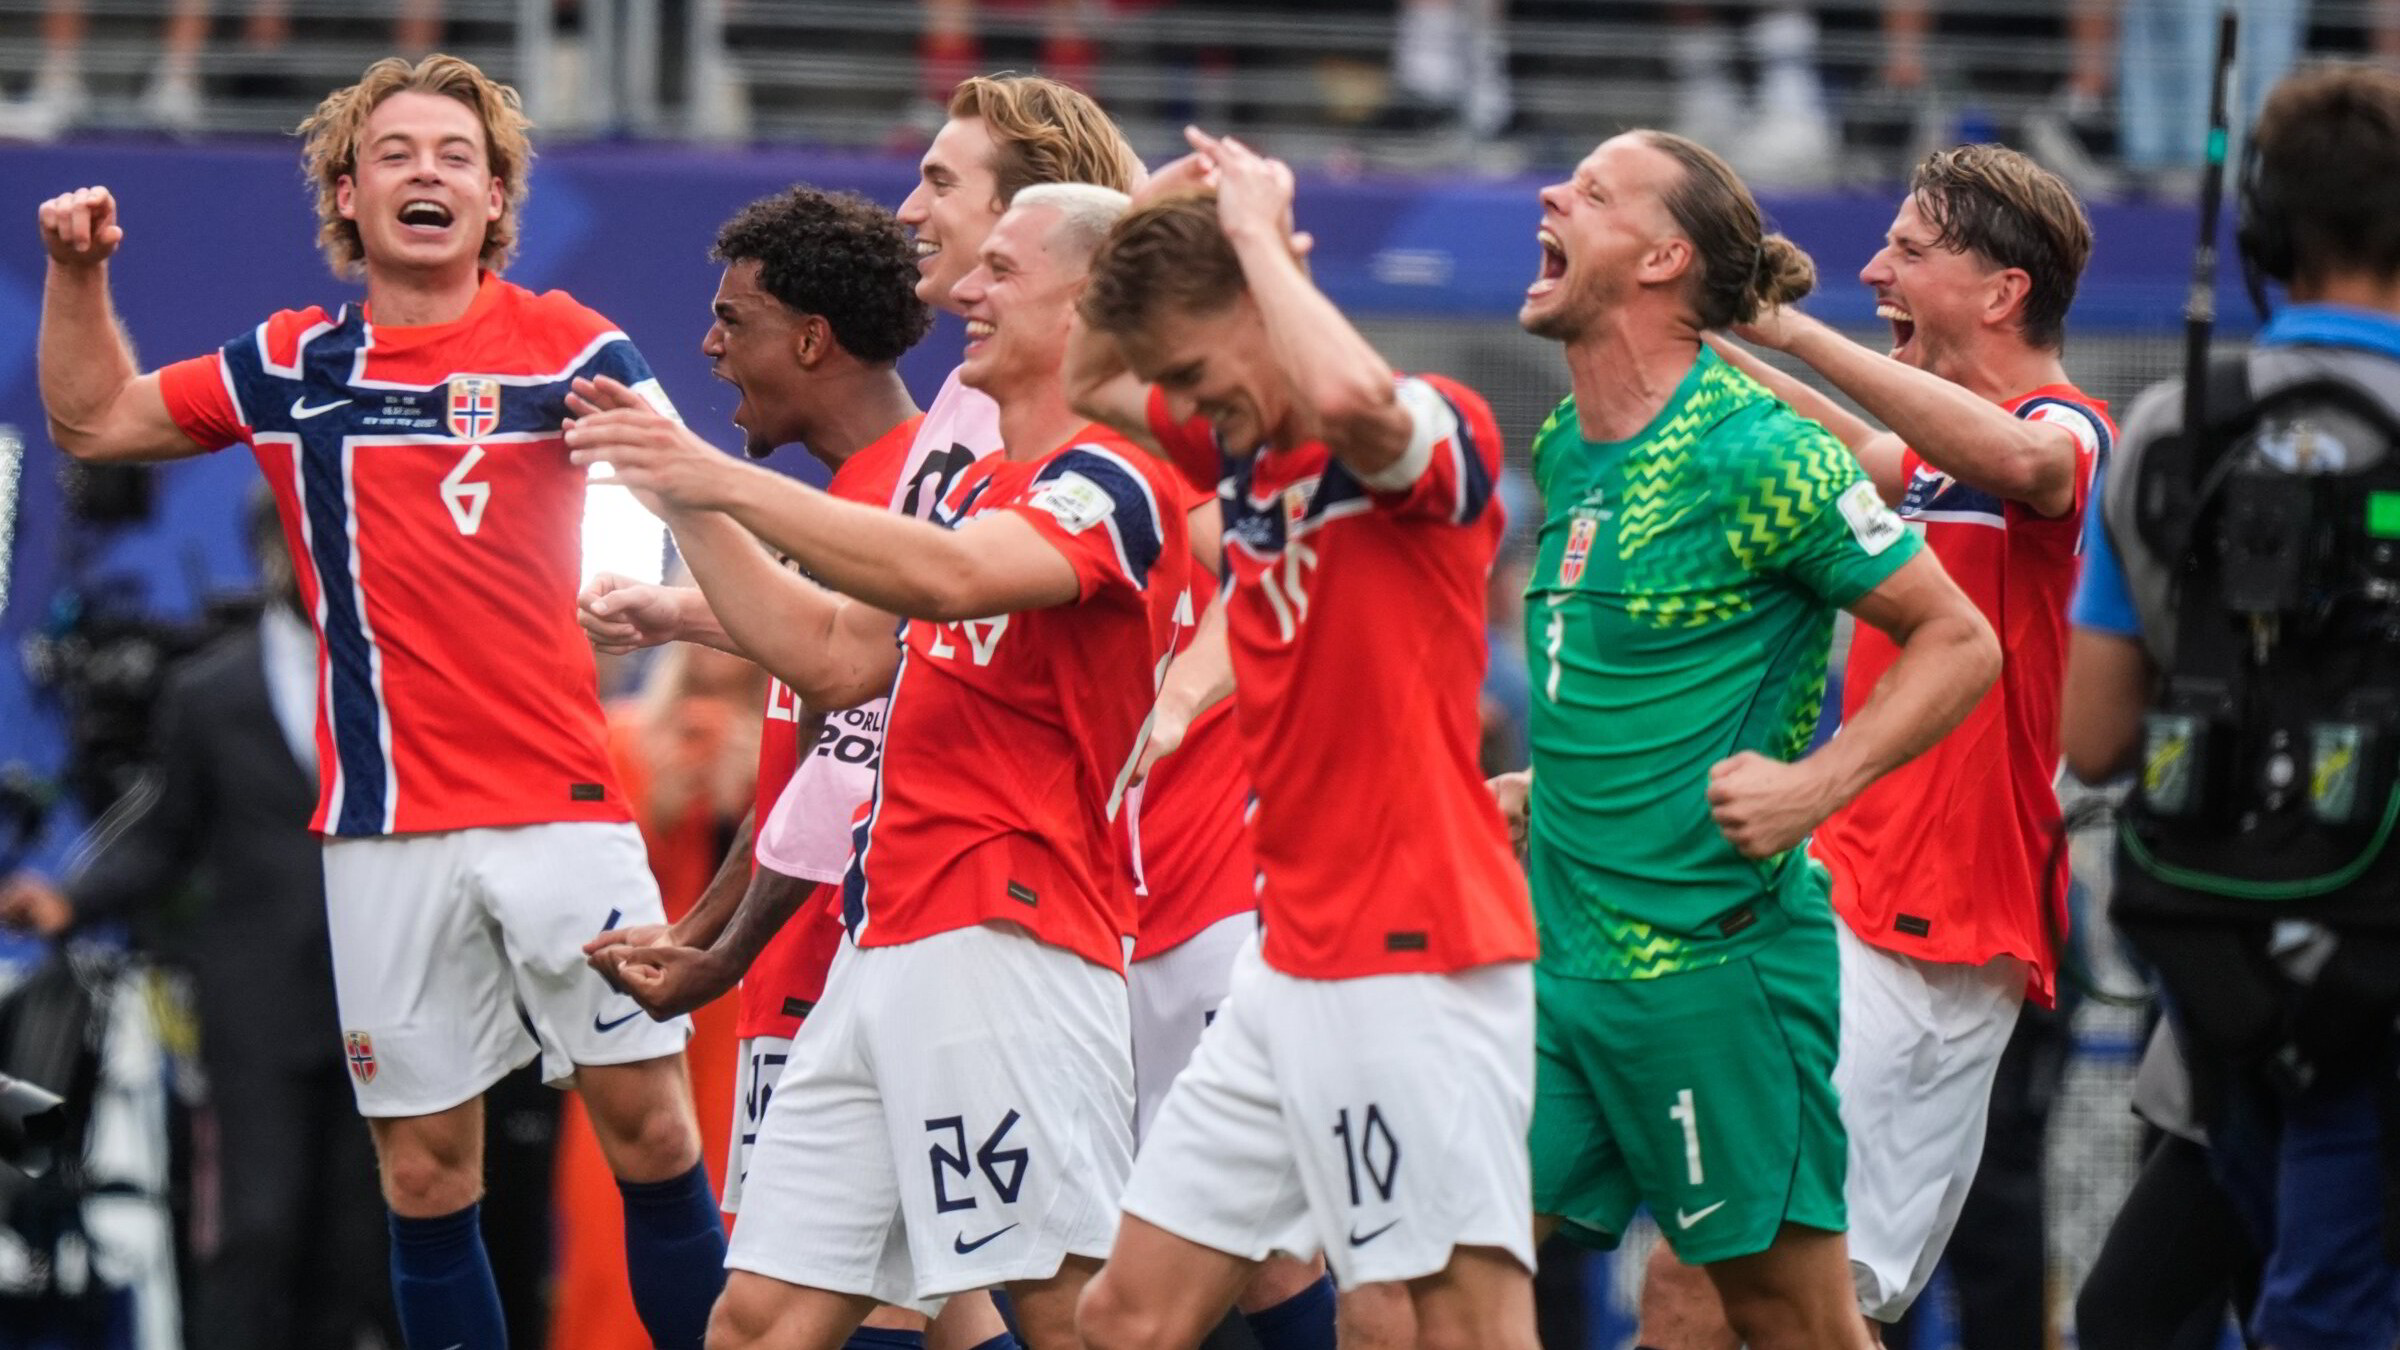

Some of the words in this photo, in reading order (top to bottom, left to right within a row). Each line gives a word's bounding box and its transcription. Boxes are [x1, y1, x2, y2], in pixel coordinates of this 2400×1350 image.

[440, 444, 491, 536] 6
[925, 1108, 1029, 1214] 26
[1333, 1103, 1400, 1206] 10
[1669, 1088, 1704, 1185] 1
